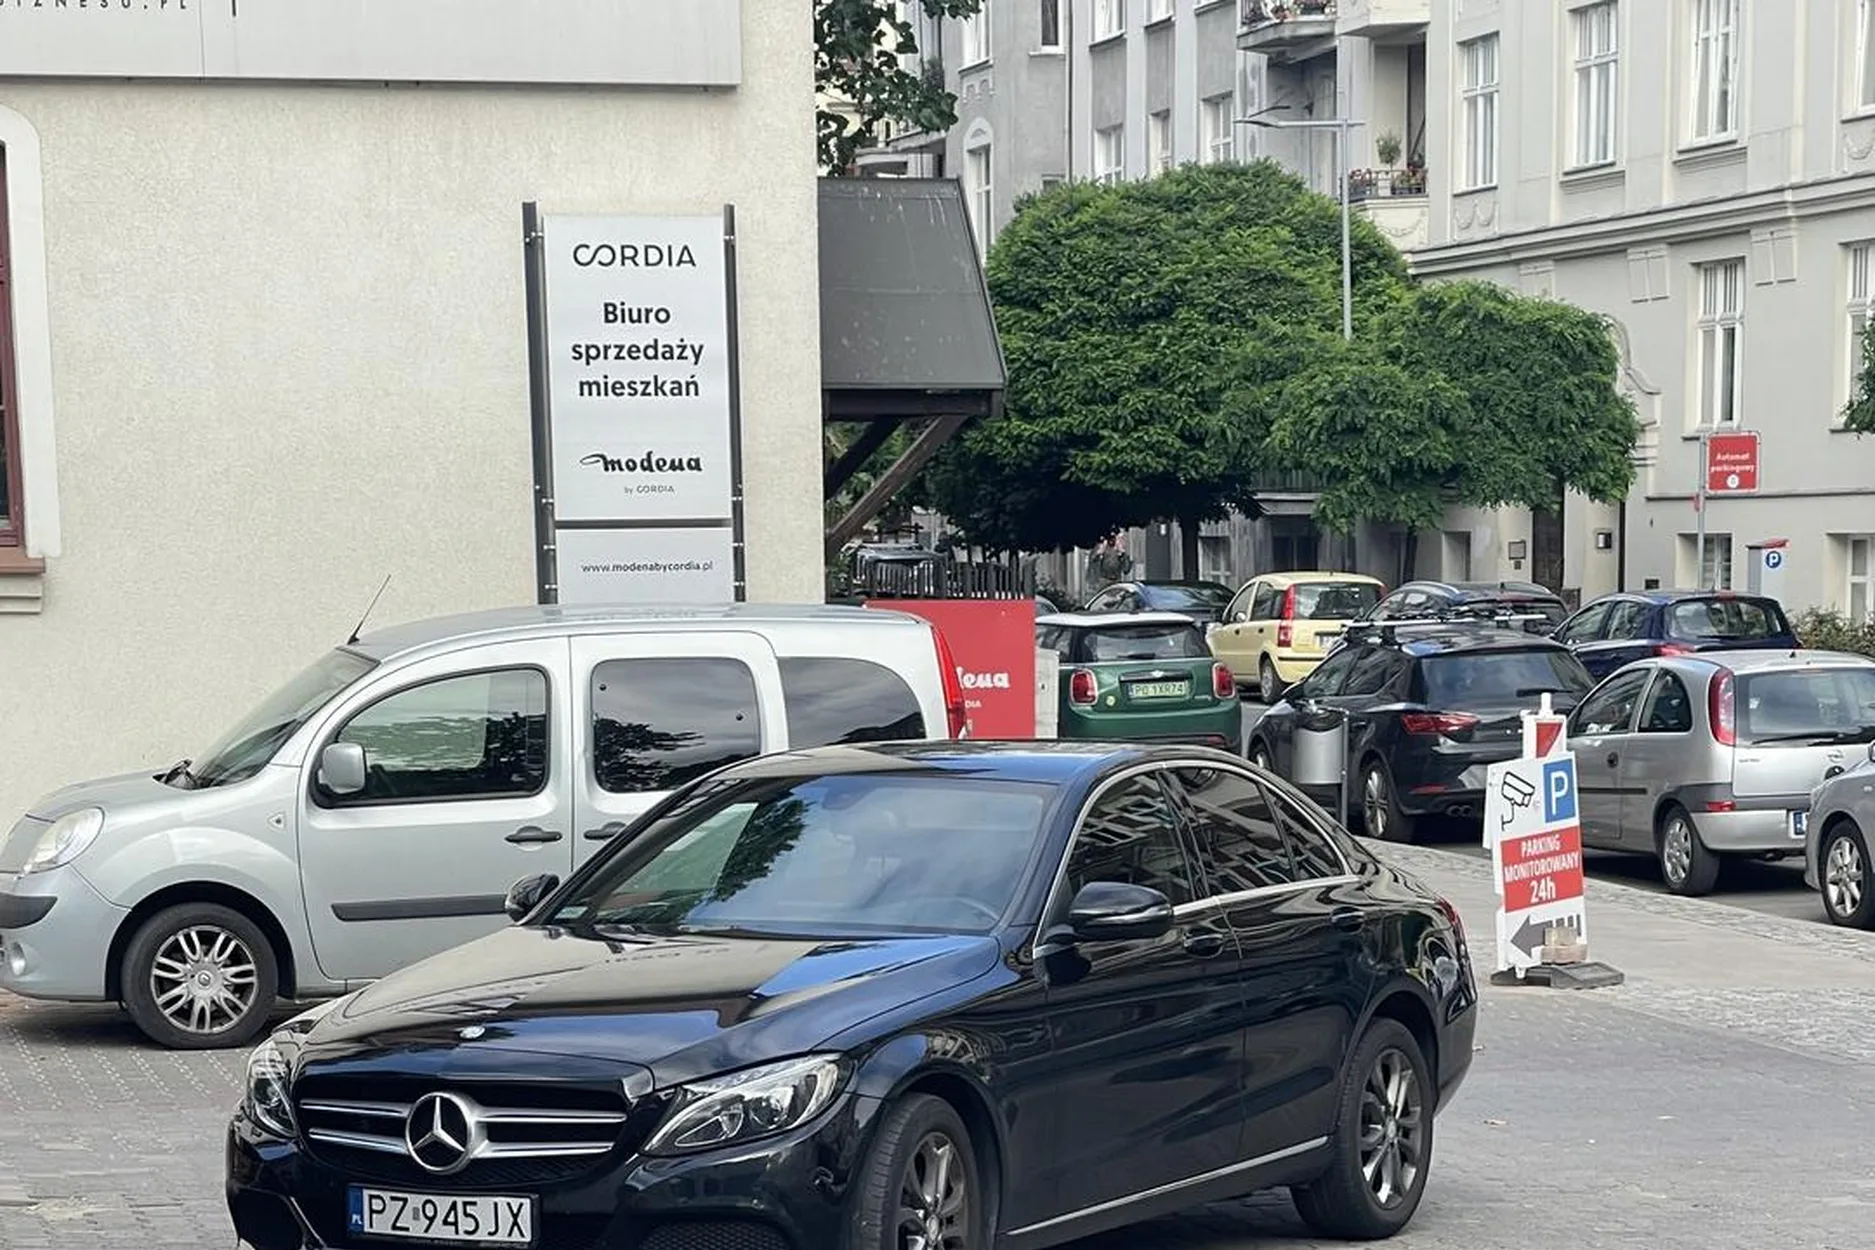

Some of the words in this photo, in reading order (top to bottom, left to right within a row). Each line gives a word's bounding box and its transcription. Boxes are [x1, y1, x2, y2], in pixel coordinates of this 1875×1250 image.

[573, 243, 697, 267] CORDIA
[603, 301, 671, 324] Biuro
[571, 338, 704, 366] sprzedaży
[578, 374, 700, 397] mieszkań
[580, 451, 703, 472] modena
[581, 559, 713, 573] www.modenabycordia.pl
[965, 700, 982, 709] DIA
[1551, 771, 1568, 814] P
[1521, 834, 1560, 856] PARKING
[1504, 854, 1579, 883] MONITOROWANY
[1530, 876, 1556, 904] 24h
[368, 1194, 410, 1231] PZ
[422, 1199, 526, 1238] 945JX
